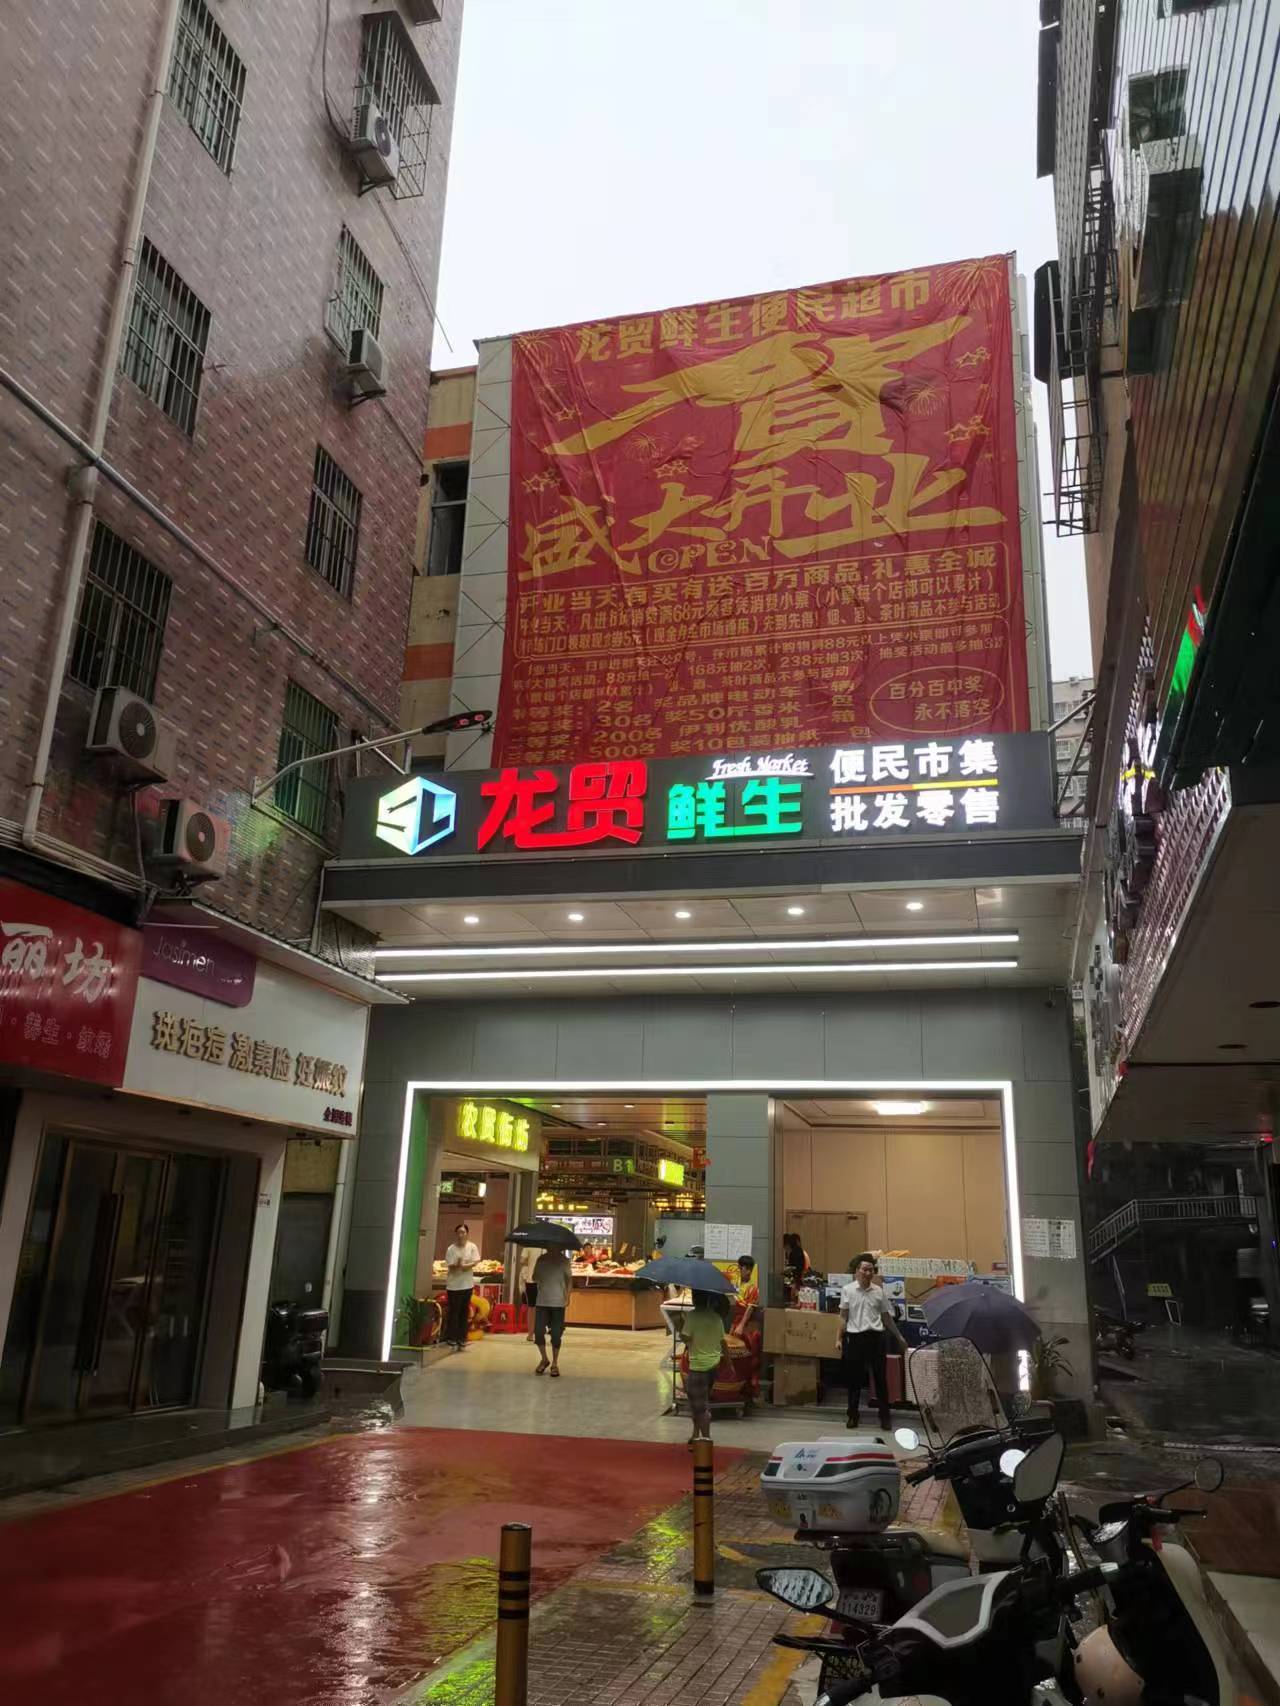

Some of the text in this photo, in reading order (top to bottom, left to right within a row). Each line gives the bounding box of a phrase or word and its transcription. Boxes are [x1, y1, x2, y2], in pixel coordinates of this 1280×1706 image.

[574, 271, 932, 362] 龙贸鲜生便民超市
[889, 676, 984, 699] 百分百中奖
[829, 738, 999, 784] 便民市集
[829, 788, 1000, 833] 批发零售
